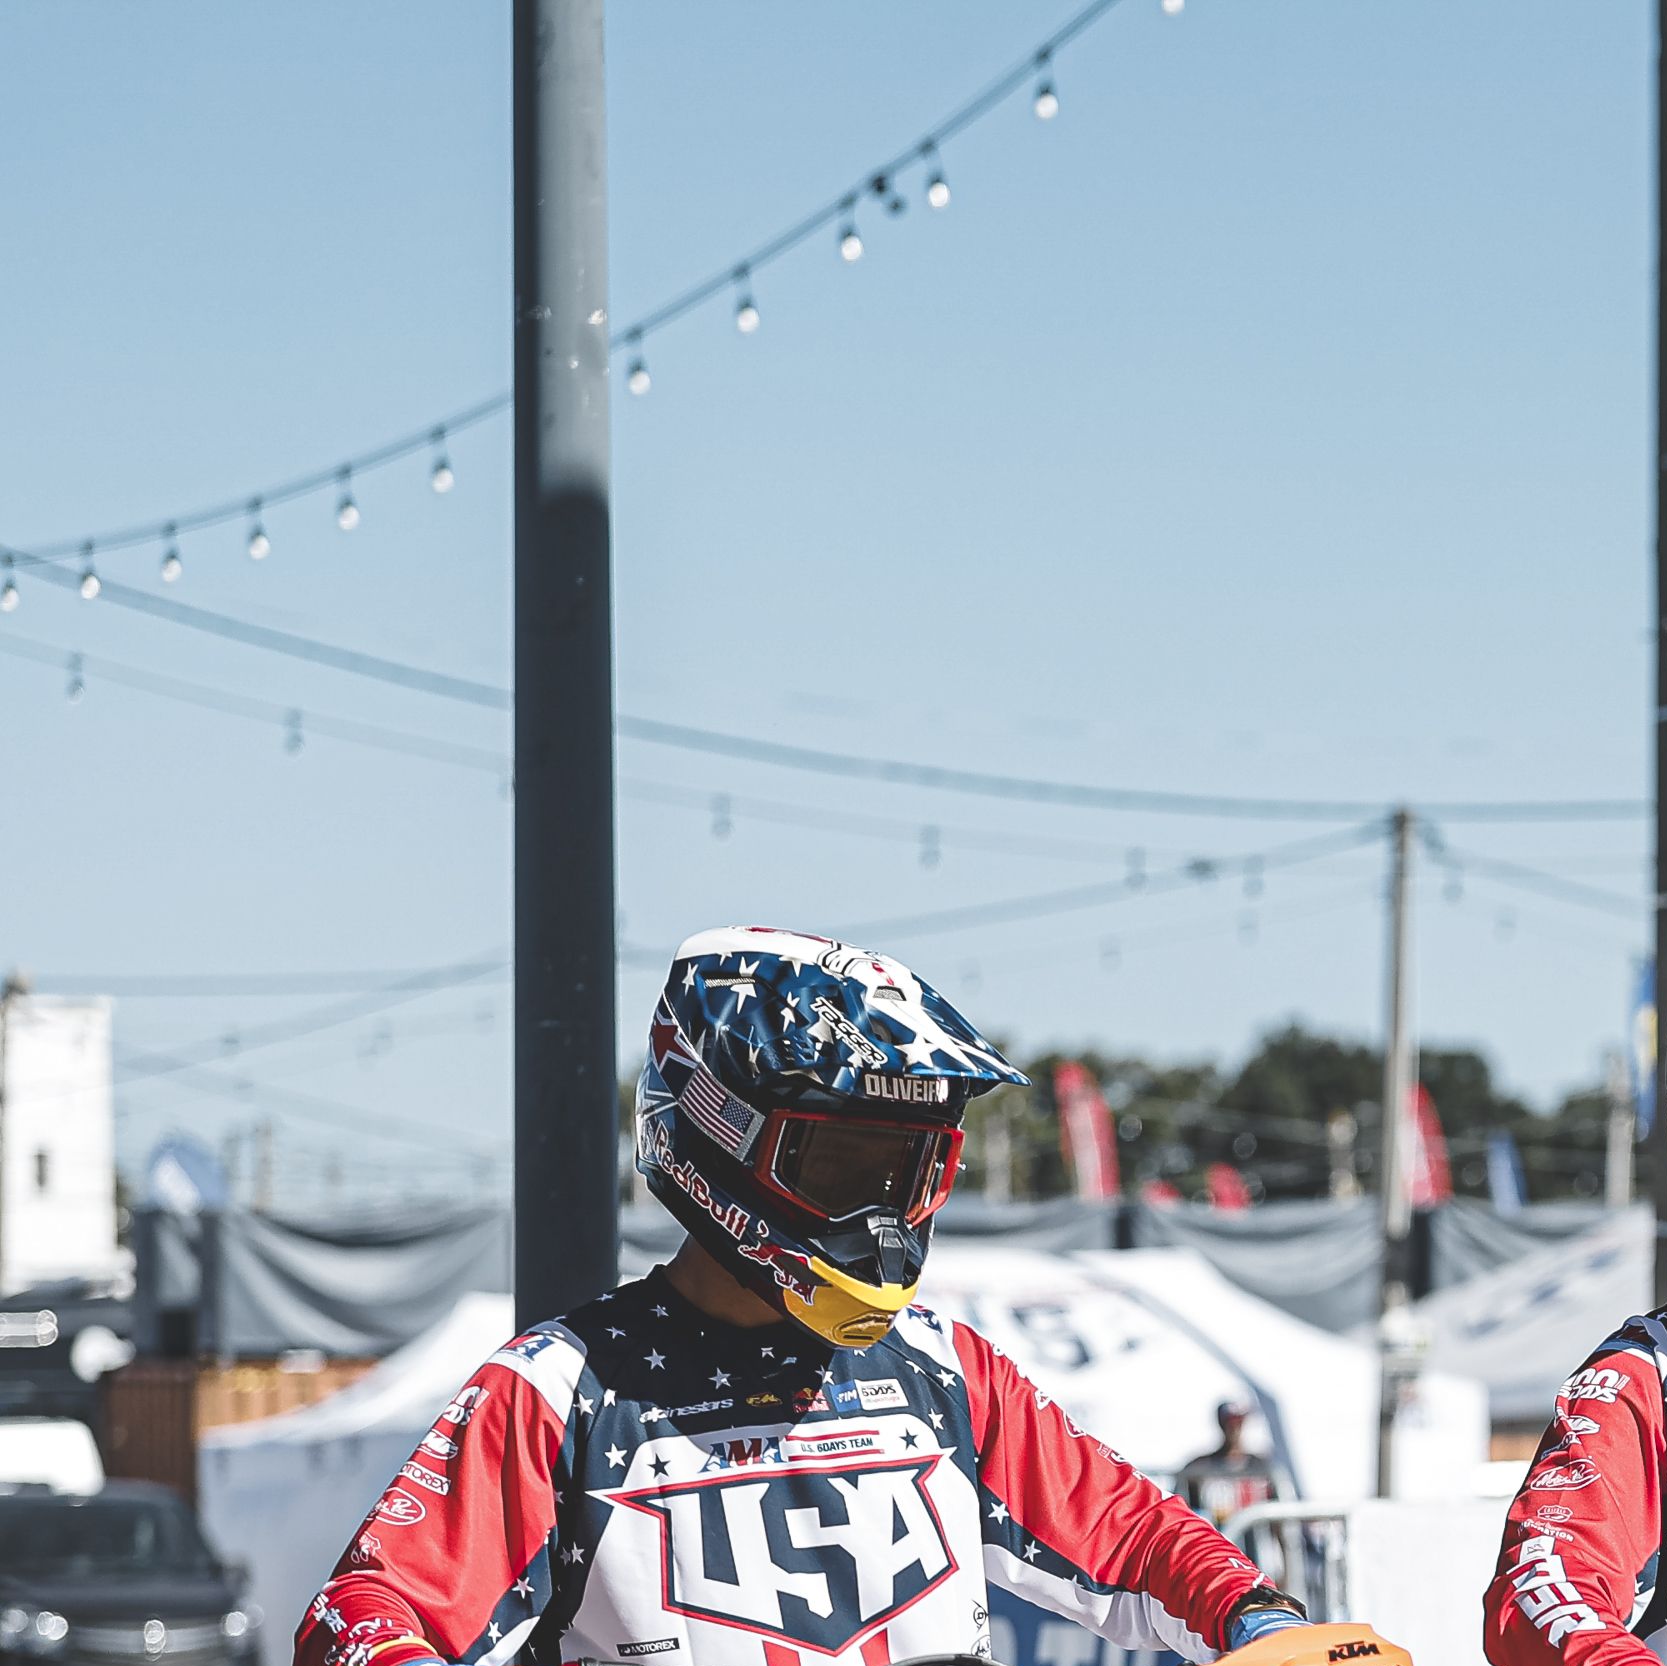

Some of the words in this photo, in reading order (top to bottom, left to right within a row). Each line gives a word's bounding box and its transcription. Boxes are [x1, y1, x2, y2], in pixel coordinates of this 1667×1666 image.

[639, 1398, 734, 1423] alpinestars
[698, 1436, 789, 1473] AMA
[850, 1437, 873, 1449] TEAM
[646, 1469, 949, 1630] USA
[1328, 1639, 1380, 1663] KTM
